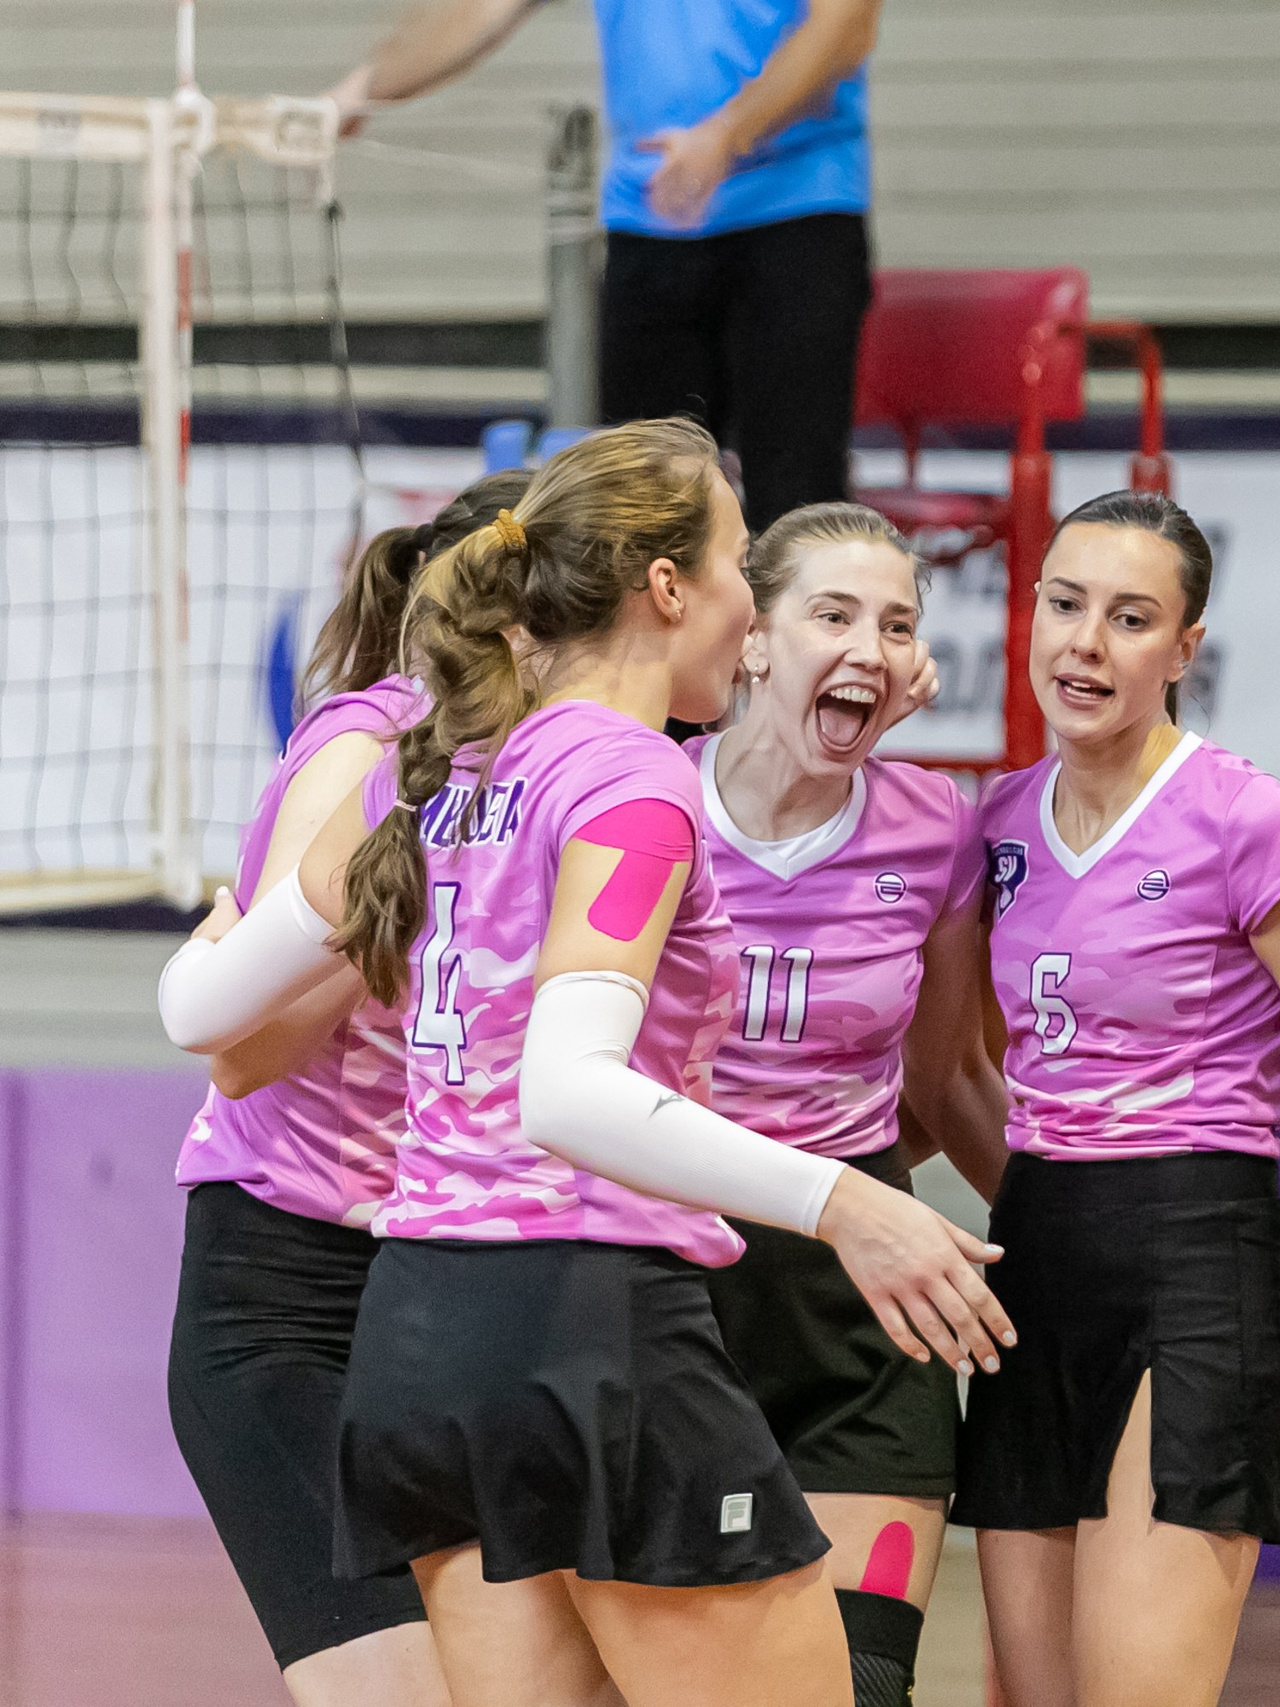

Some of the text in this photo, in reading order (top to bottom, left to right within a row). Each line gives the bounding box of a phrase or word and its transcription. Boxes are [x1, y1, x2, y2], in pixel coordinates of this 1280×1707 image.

[411, 880, 467, 1086] 4
[740, 944, 814, 1044] 11
[1029, 951, 1079, 1056] 6
